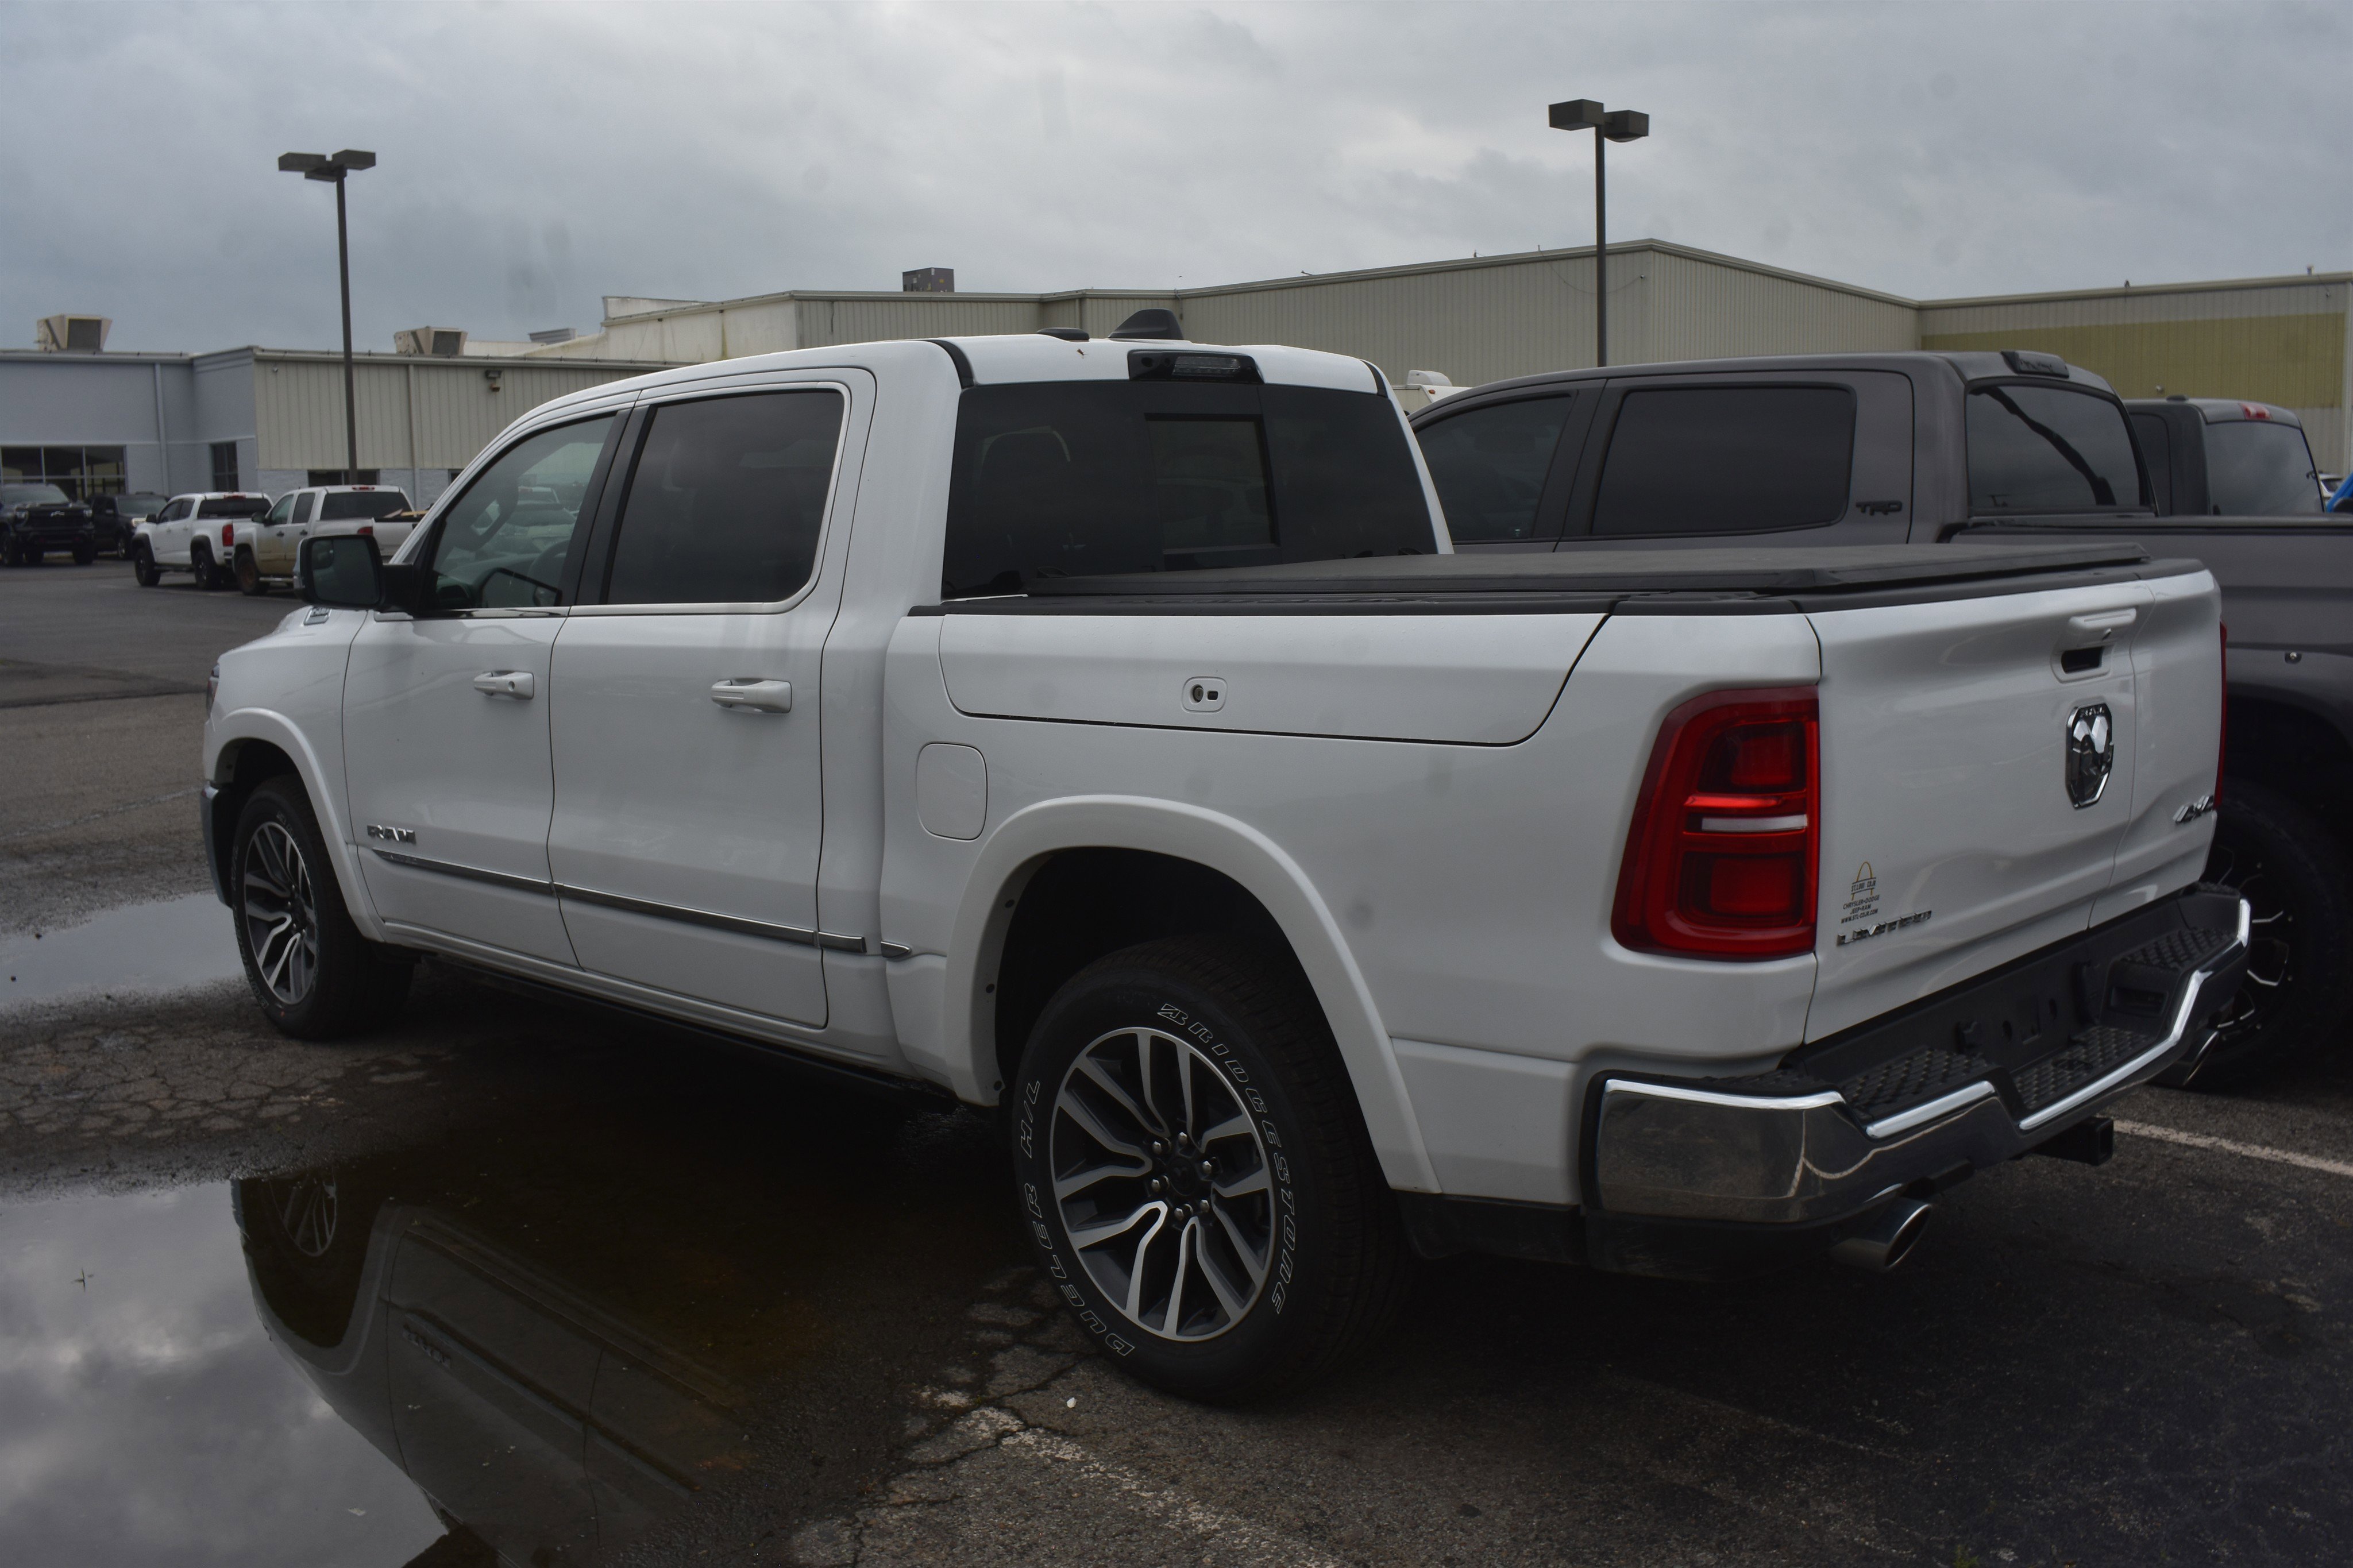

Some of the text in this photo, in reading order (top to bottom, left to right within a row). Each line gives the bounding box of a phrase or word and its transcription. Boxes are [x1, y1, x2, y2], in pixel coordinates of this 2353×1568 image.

[1856, 500, 1902, 516] TRD
[367, 824, 416, 845] RAM
[1020, 1080, 1135, 1356] DUELER H/L
[1157, 1003, 1295, 1315] BRIDGESTONE
